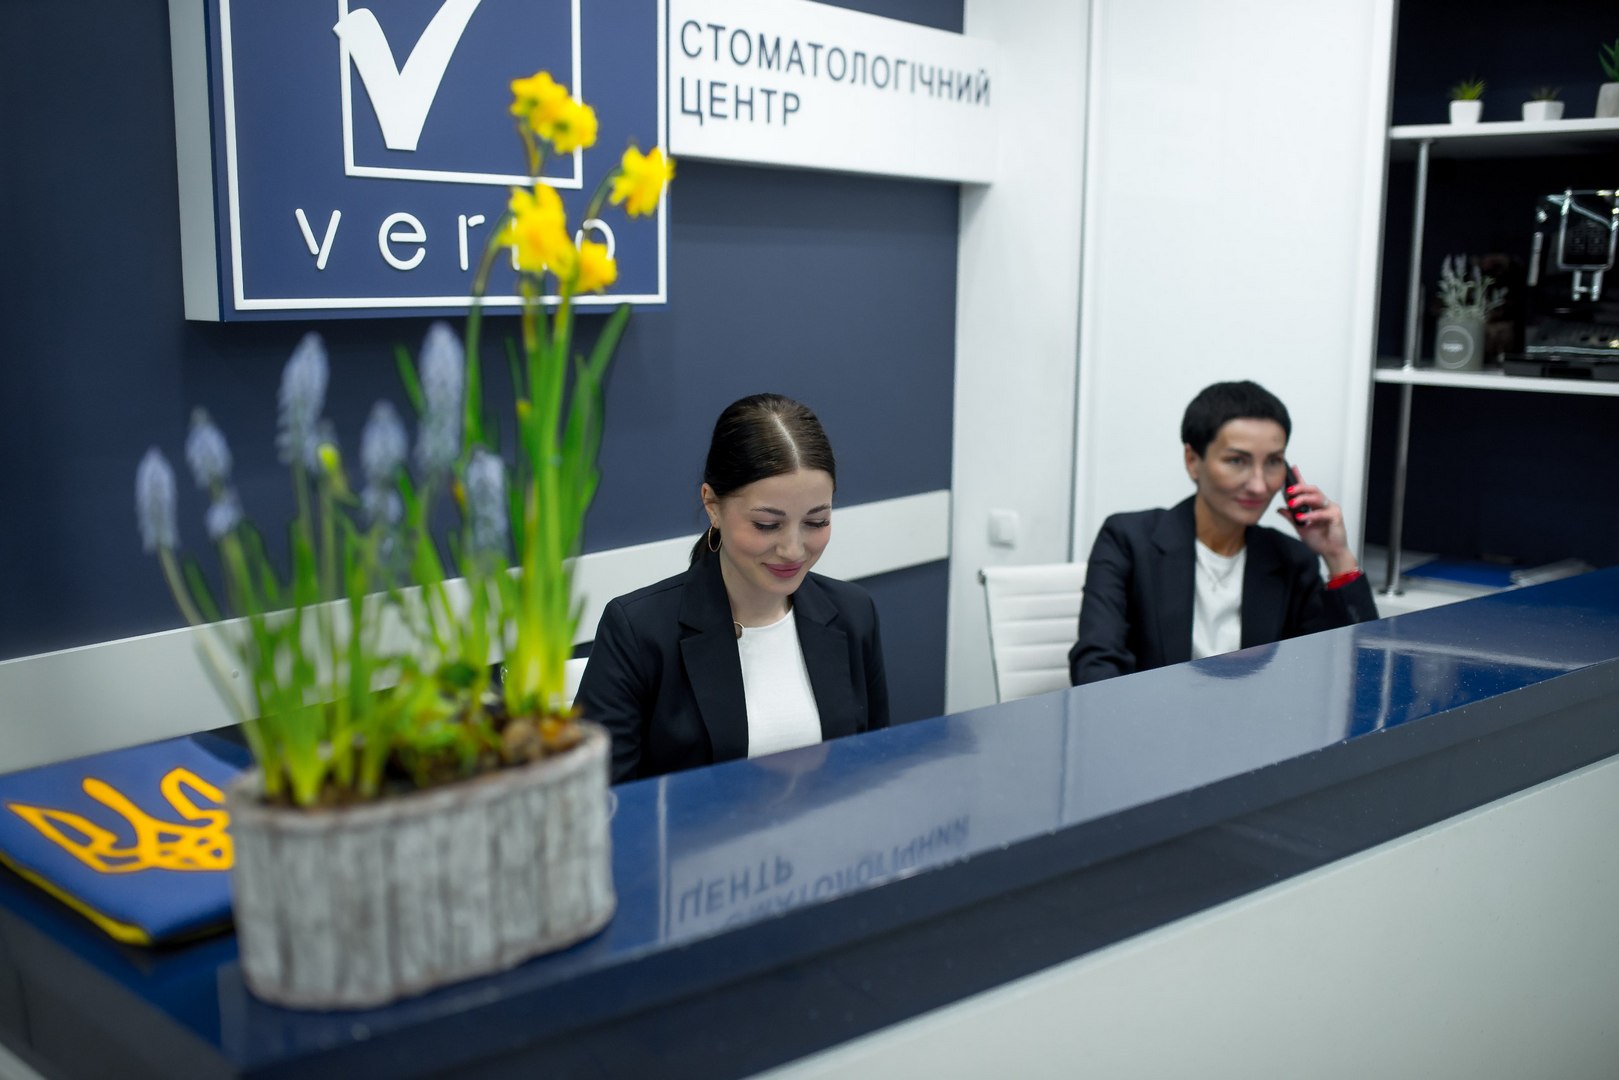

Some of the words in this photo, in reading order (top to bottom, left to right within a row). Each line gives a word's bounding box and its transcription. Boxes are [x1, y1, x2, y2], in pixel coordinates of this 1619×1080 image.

[680, 20, 991, 107] СТОМАТОЛОГІЧНИЙ
[680, 77, 800, 126] ЦЕНТР
[295, 208, 616, 271] vero
